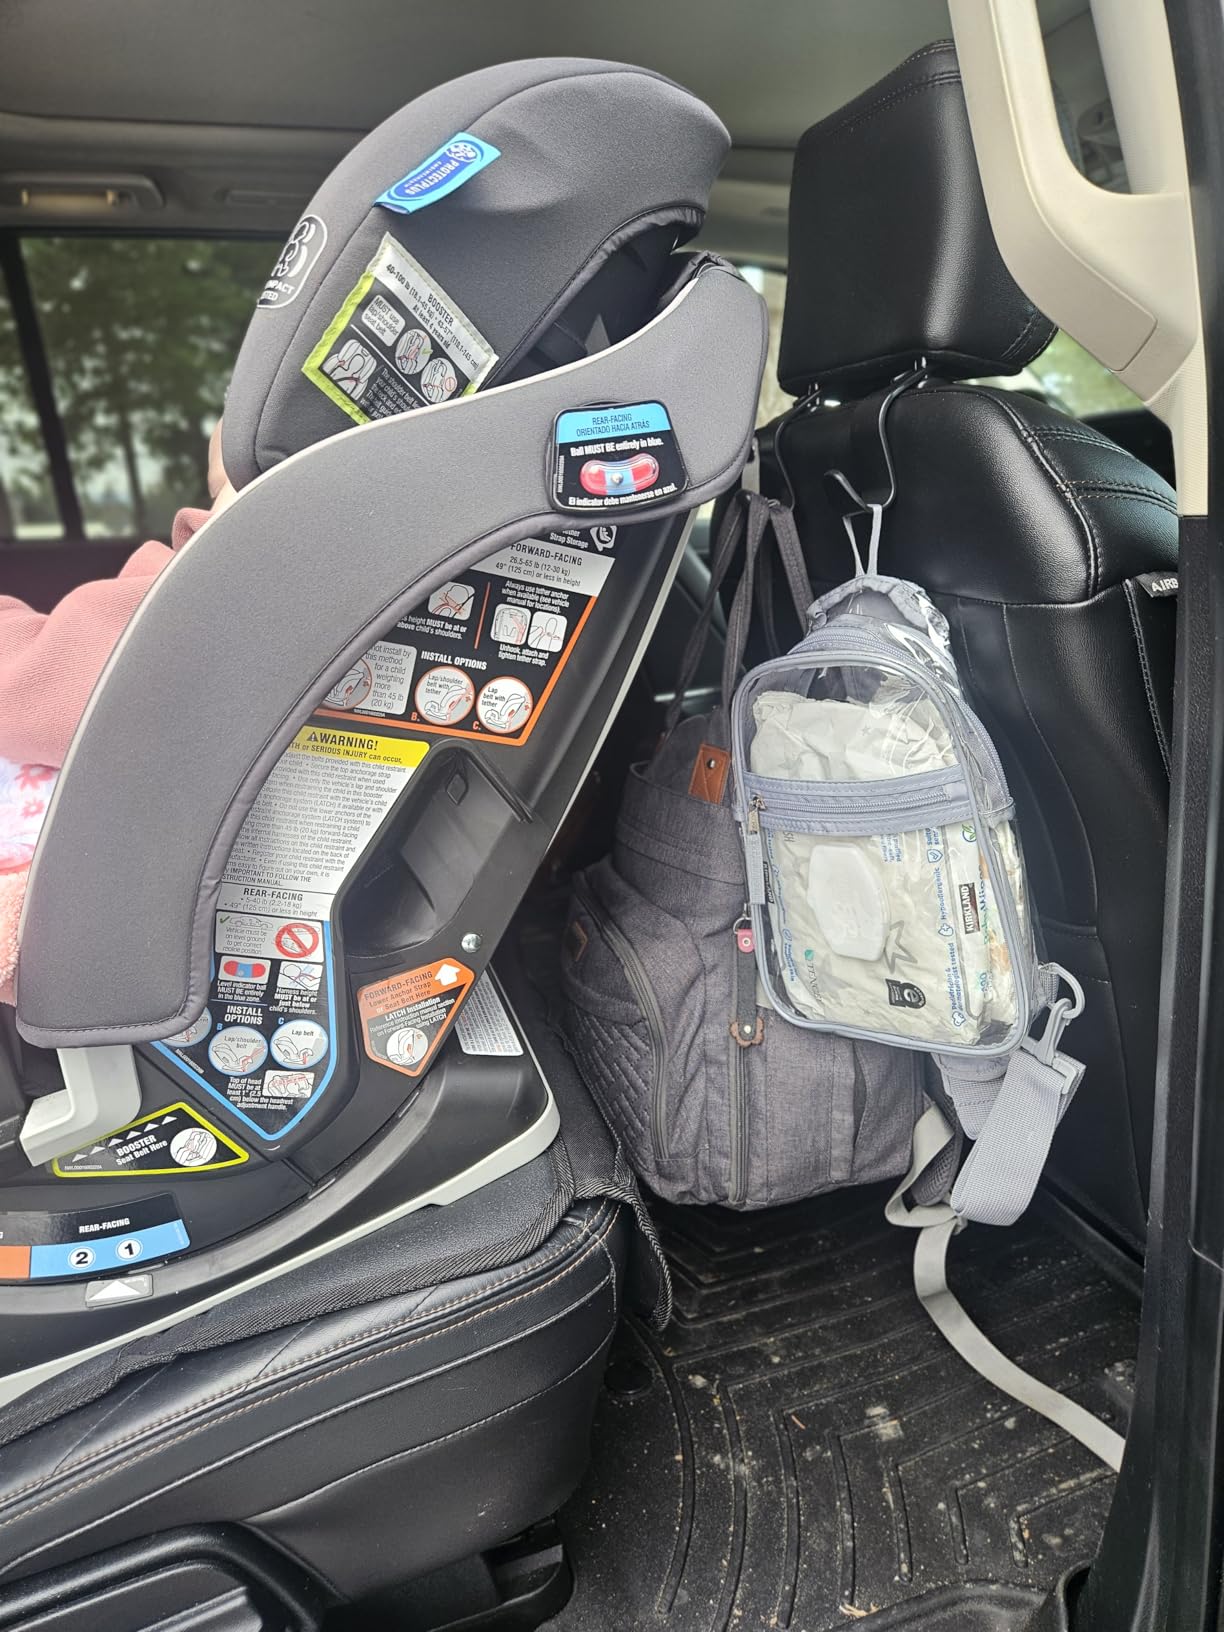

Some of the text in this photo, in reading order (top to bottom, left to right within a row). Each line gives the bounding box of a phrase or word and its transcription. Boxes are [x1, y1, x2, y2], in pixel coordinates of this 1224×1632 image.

[405, 160, 460, 195] PROTECTPLUS
[426, 293, 454, 325] BOOSTER
[591, 412, 632, 425] REAR-FACING
[575, 422, 630, 437] ORIENTADO HACIA
[549, 532, 589, 549] Strap Storage
[509, 542, 583, 566] FORWARD-FACING
[508, 556, 572, 577] 26.5-65 lb (12-30 kg)
[506, 564, 522, 575] (125
[521, 567, 534, 577] cm)
[543, 572, 555, 581] less
[562, 576, 581, 588] height
[504, 580, 569, 600] Always use tether anchor
[1152, 578, 1178, 591] AIRB
[382, 645, 411, 658] install by
[377, 654, 402, 665] method
[420, 650, 487, 670] INSTALL OPTIONS
[374, 662, 384, 670] for
[390, 665, 406, 674] child
[375, 672, 404, 684] weighing
[427, 674, 463, 686] Lap/shoulder
[373, 681, 391, 691] more
[425, 687, 441, 695] tether
[486, 686, 498, 694] Lap
[372, 689, 404, 701] than 45 lb
[482, 692, 495, 700] belt
[371, 697, 394, 709] (20 kg)
[480, 699, 497, 707] tether
[317, 732, 379, 752] WARNING!
[310, 744, 341, 756] SERIOUS
[341, 749, 367, 760] INJURY
[367, 752, 380, 760] can
[230, 866, 264, 879] IMPORTANT
[276, 872, 299, 883] FOLLOW
[299, 874, 312, 884] THE
[243, 888, 303, 901] REAR-FACING
[934, 866, 947, 920] Hypoallergenic
[960, 885, 974, 931] KIRKLAND
[363, 971, 433, 1000] FORWARD-FACING
[946, 973, 956, 1010] Pediatrician
[952, 965, 963, 1011] dermatologist
[273, 993, 293, 1001] MUST
[368, 980, 432, 1008] Lower Anchor Strap
[383, 988, 431, 1010] Seat Belt Here
[226, 1005, 264, 1017] INSTALL
[384, 996, 441, 1021] LATCH Installation
[223, 1013, 263, 1026] OPTIONS
[277, 1017, 285, 1025] C
[428, 1012, 446, 1023] LATCH
[223, 1035, 261, 1045] Lap/shoulder
[291, 1028, 314, 1037] Lap belt
[236, 1042, 247, 1050] belt
[115, 1135, 157, 1157] BOOSTER
[115, 1139, 169, 1166] Seat Belt Here
[77, 1218, 130, 1234] REAR-FACING
[73, 1241, 134, 1265] 2 1
